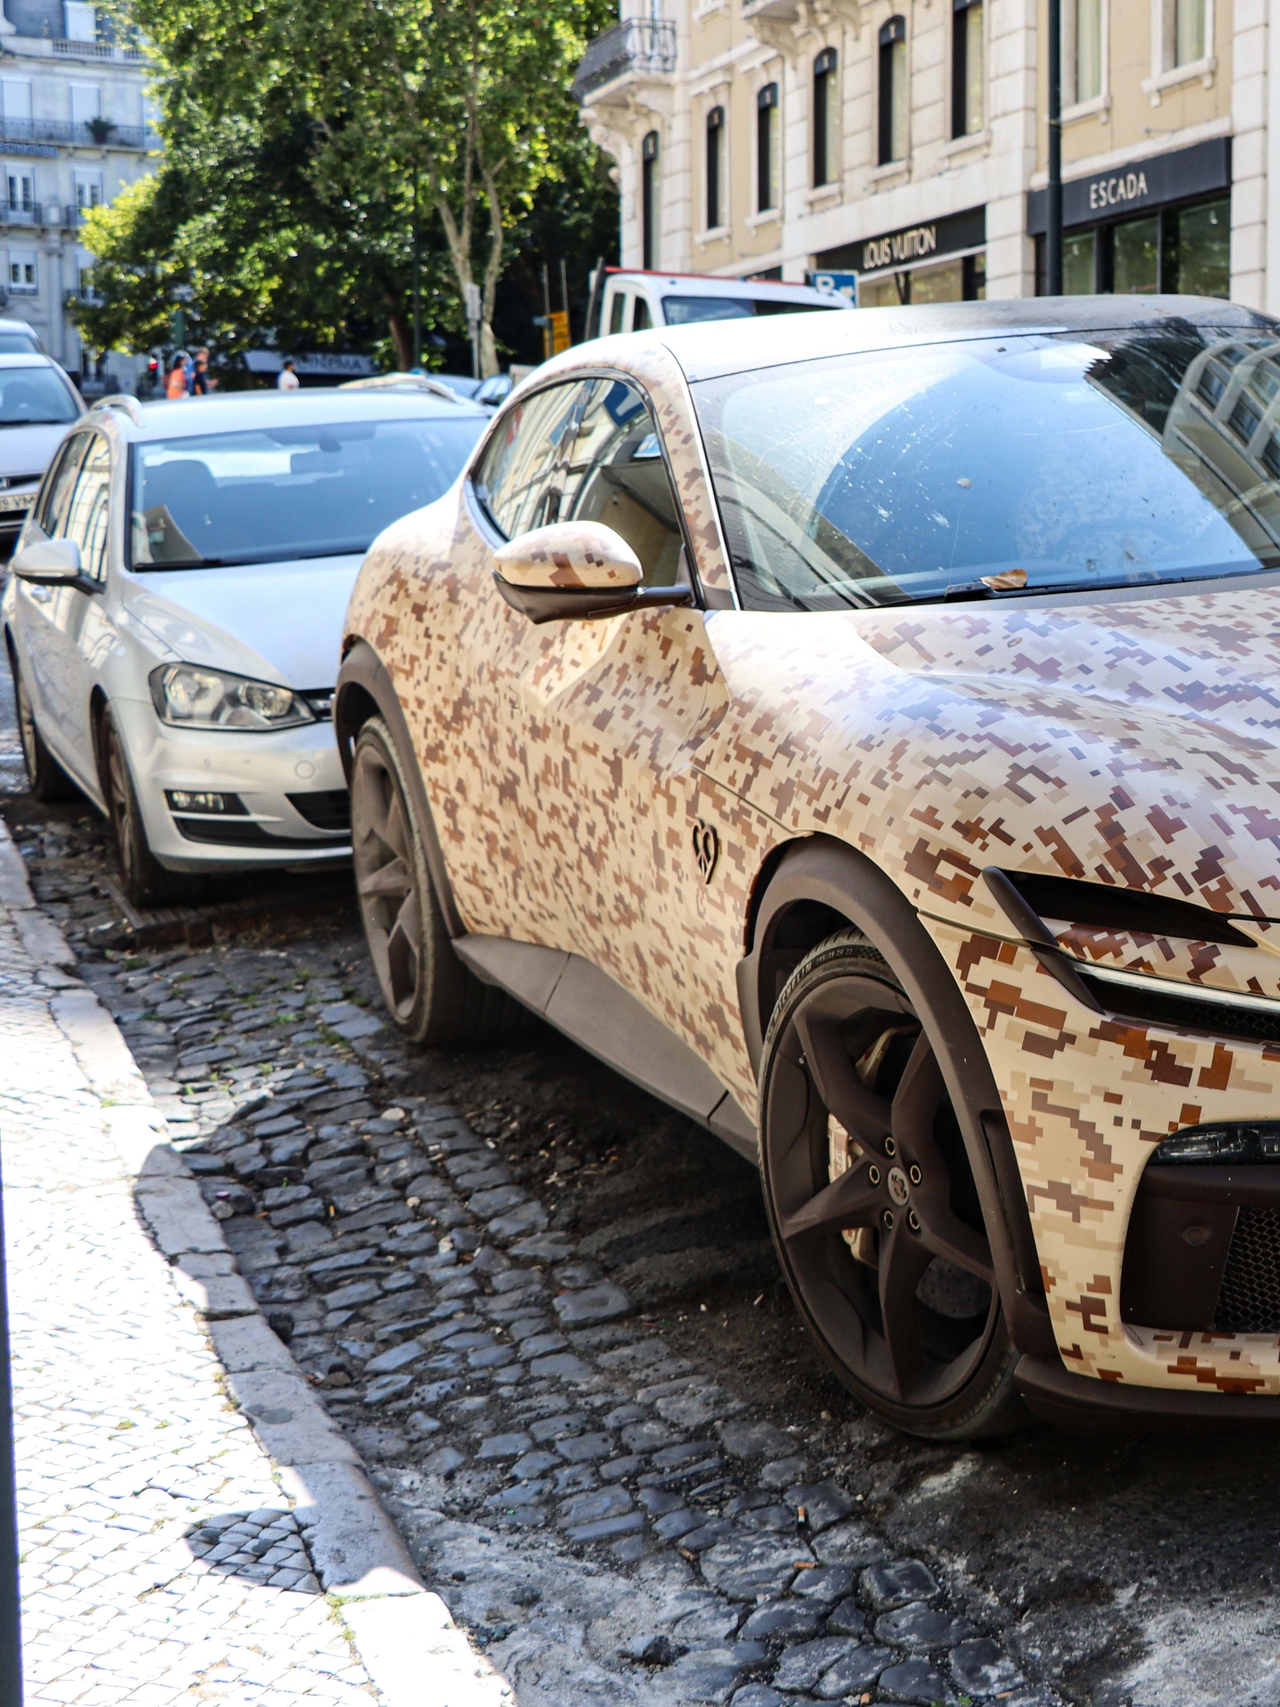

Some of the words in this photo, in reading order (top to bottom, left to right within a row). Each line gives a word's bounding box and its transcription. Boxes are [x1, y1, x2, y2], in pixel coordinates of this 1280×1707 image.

[1089, 171, 1149, 210] ESCADA
[863, 237, 892, 270] LOUIS
[891, 225, 937, 261] VUITTON
